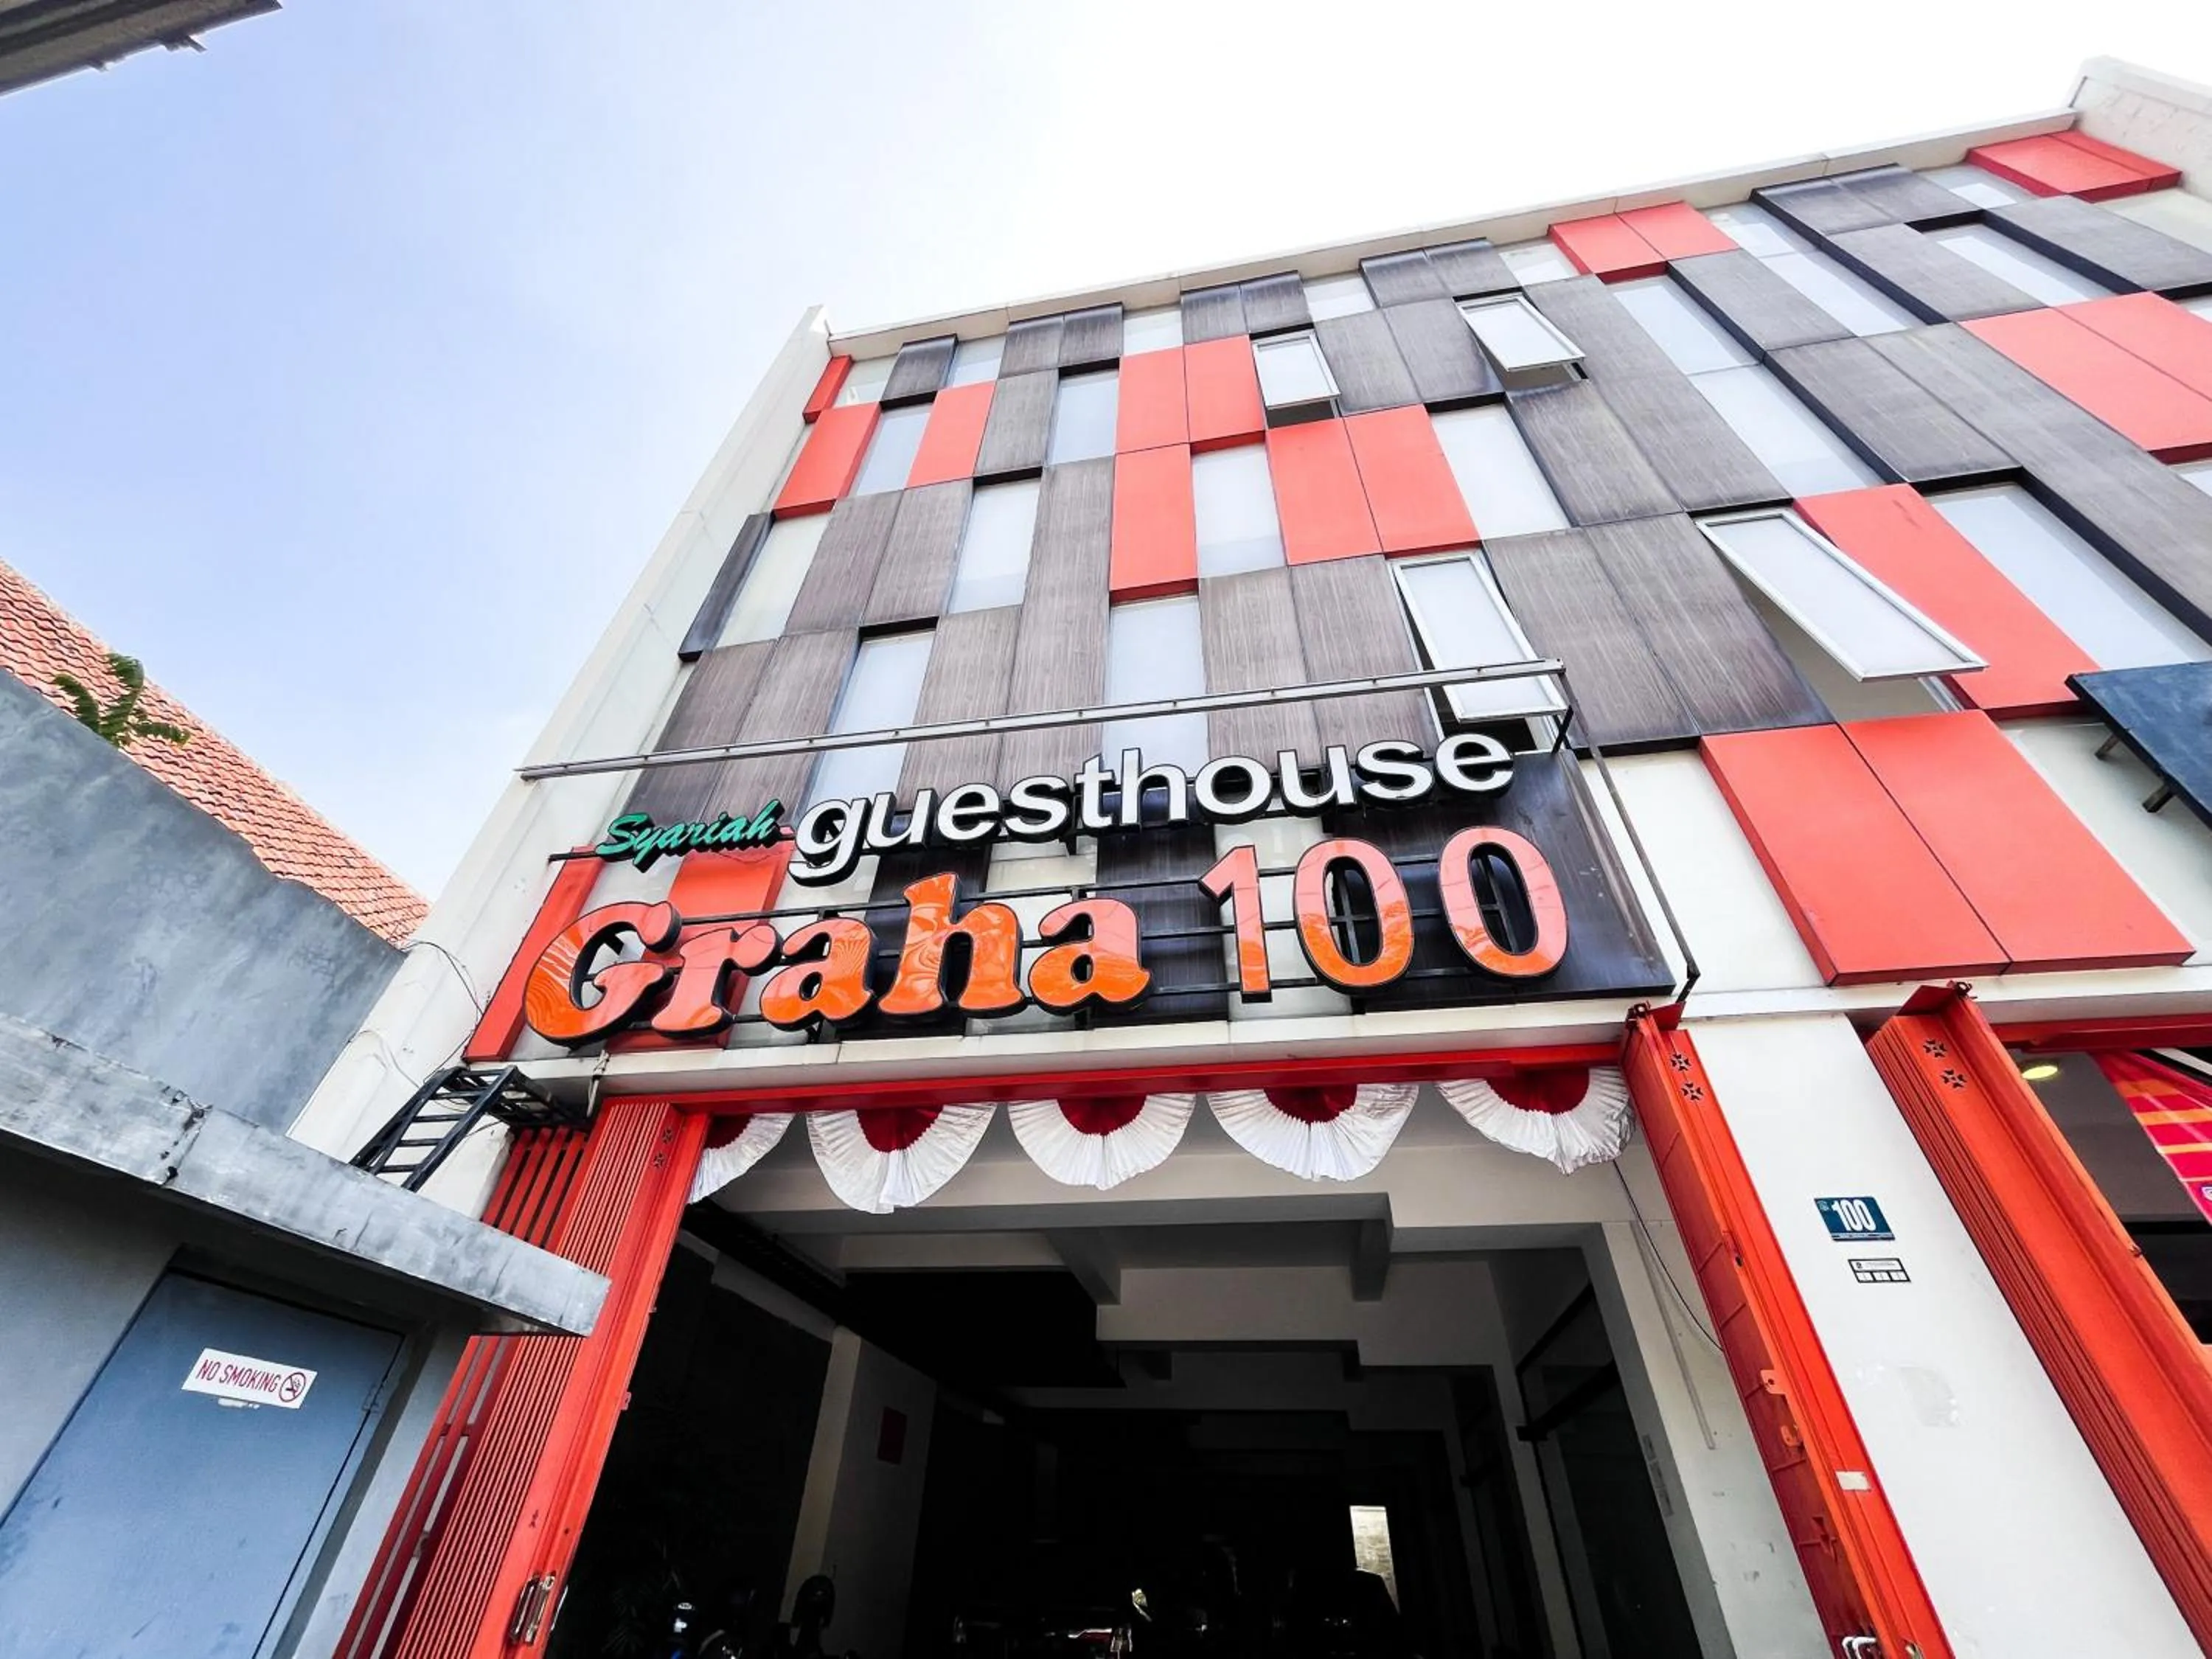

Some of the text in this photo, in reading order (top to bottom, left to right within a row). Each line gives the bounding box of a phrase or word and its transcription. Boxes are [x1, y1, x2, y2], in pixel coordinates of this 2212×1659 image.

[595, 799, 785, 872] Syariah
[792, 733, 1514, 883] guesthouse
[524, 827, 1569, 1043] Graha 100
[1831, 1199, 1877, 1231] 100
[196, 1359, 281, 1392] NO SMOKING
